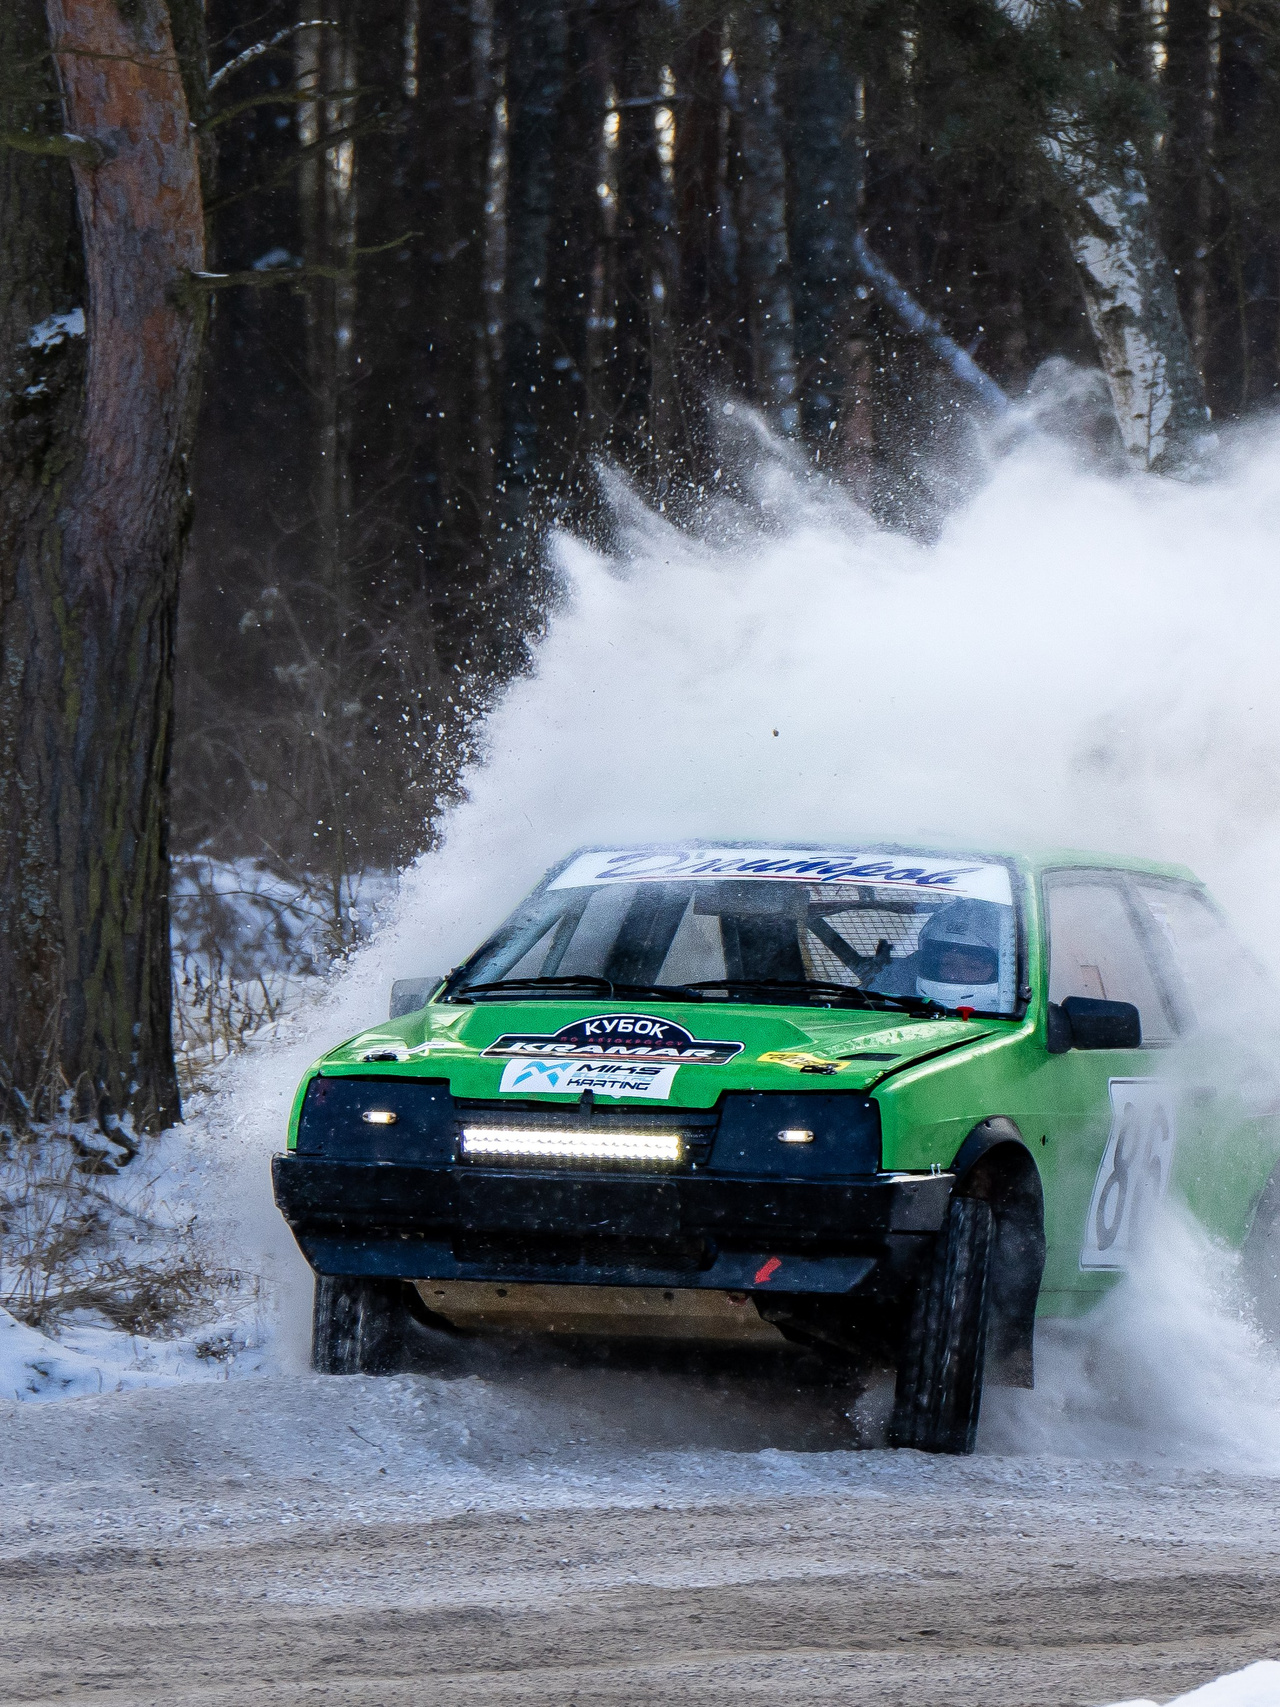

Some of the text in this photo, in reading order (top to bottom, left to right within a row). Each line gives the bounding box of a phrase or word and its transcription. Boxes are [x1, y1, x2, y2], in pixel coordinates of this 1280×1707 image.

[584, 1018, 670, 1039] КУБОК
[506, 1042, 717, 1058] KRAMAR
[576, 1063, 666, 1075] MIKS
[566, 1078, 652, 1091] KARTING
